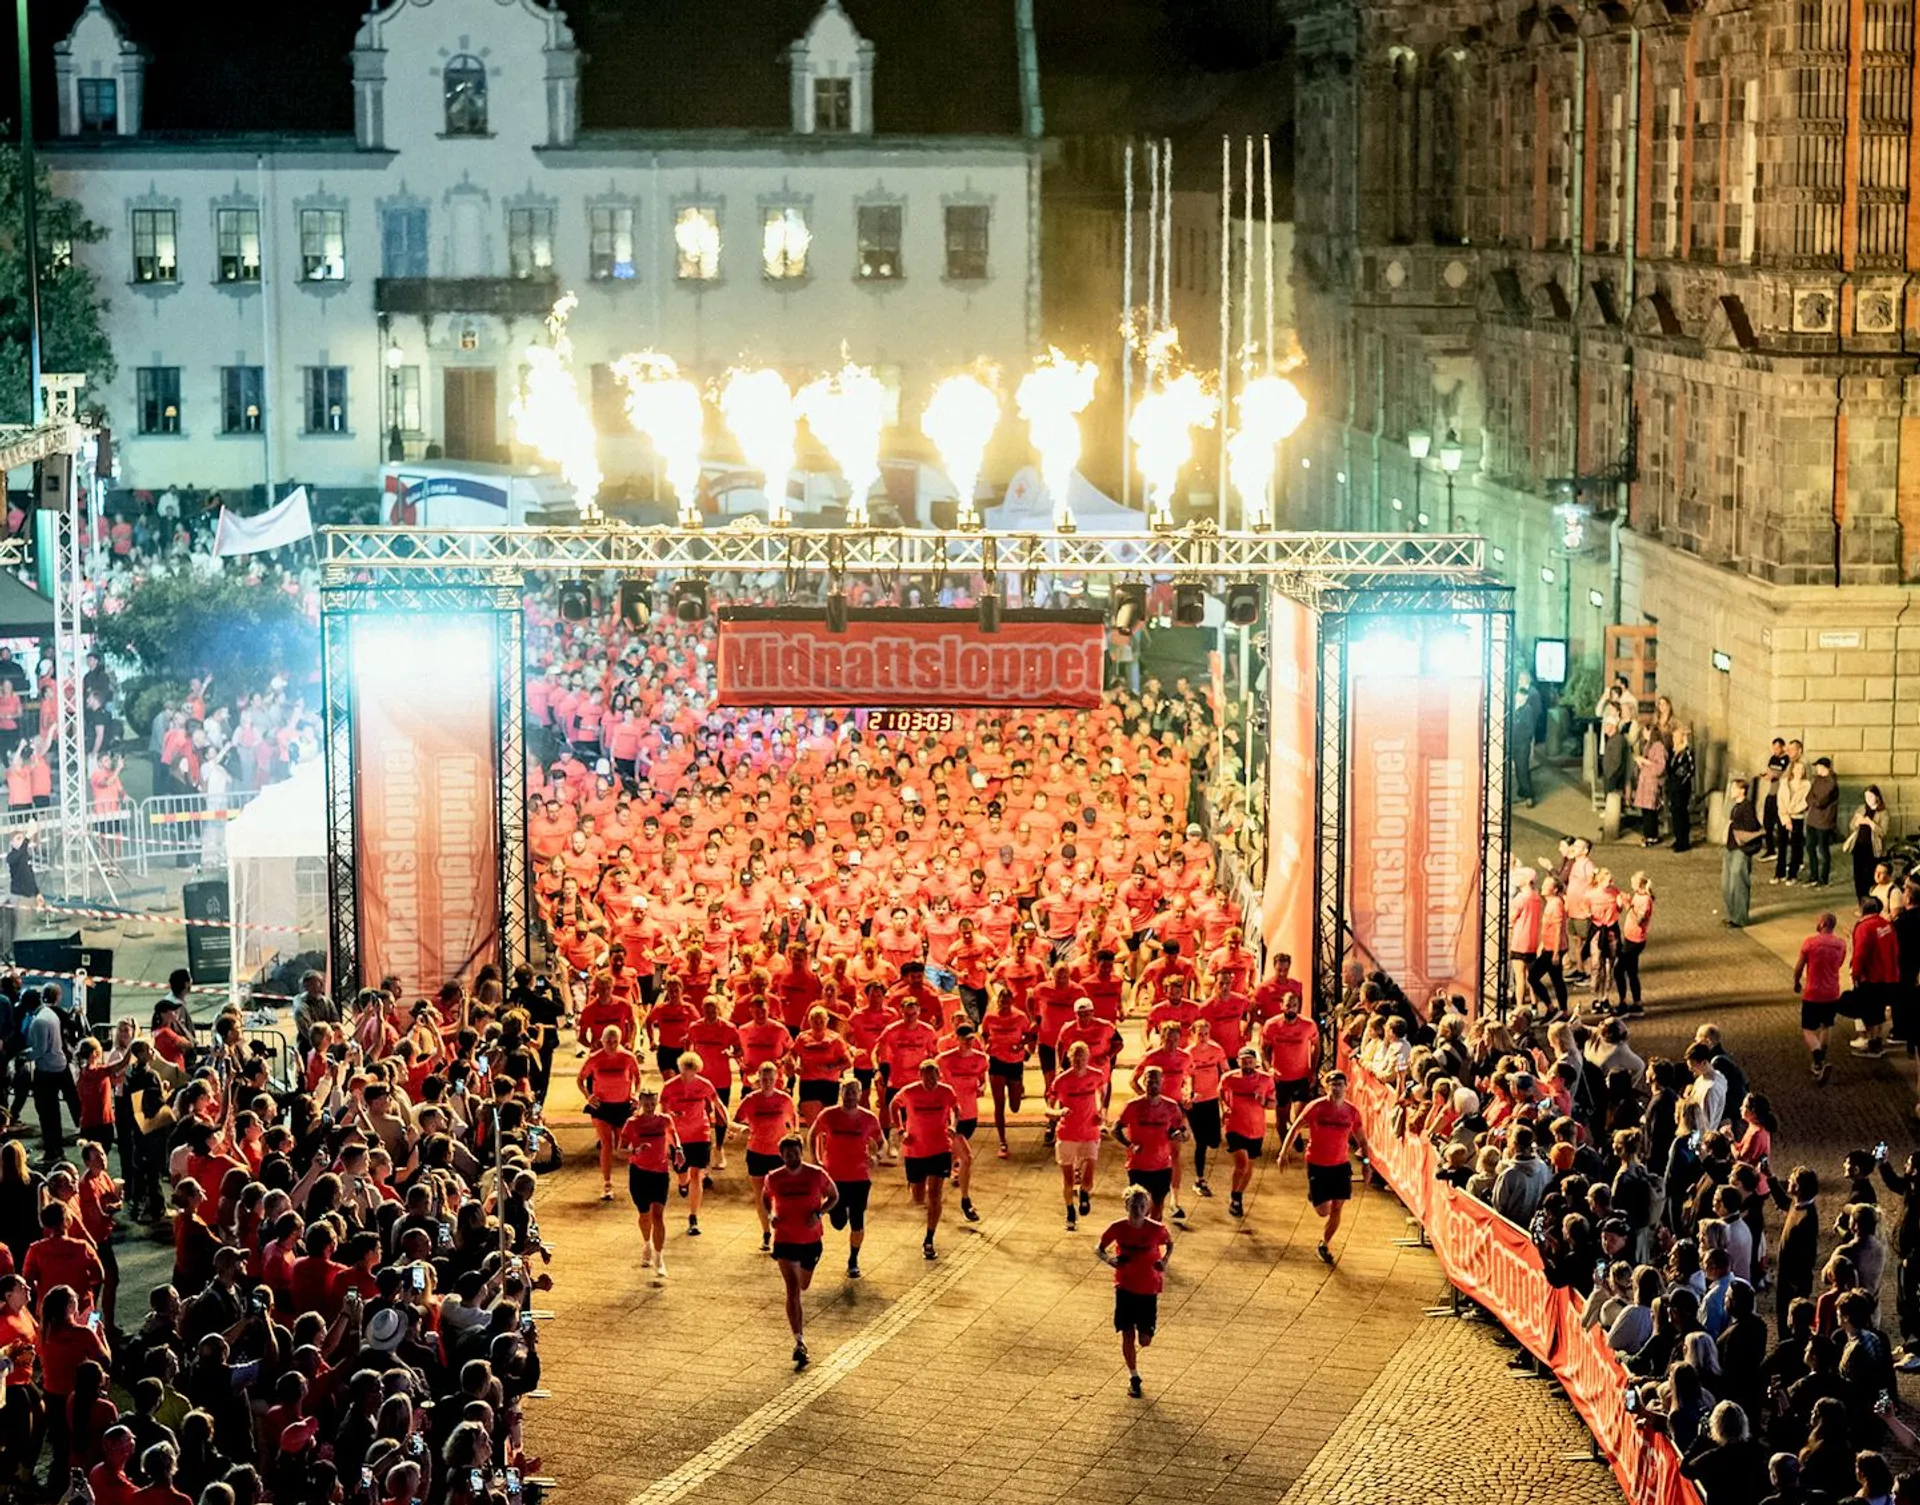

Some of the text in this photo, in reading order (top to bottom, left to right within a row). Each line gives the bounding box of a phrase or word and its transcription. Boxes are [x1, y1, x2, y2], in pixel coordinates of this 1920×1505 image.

[720, 632, 1103, 698] Midnattsloppet
[438, 756, 477, 917] Midnight
[1425, 758, 1464, 979] Midnight Run
